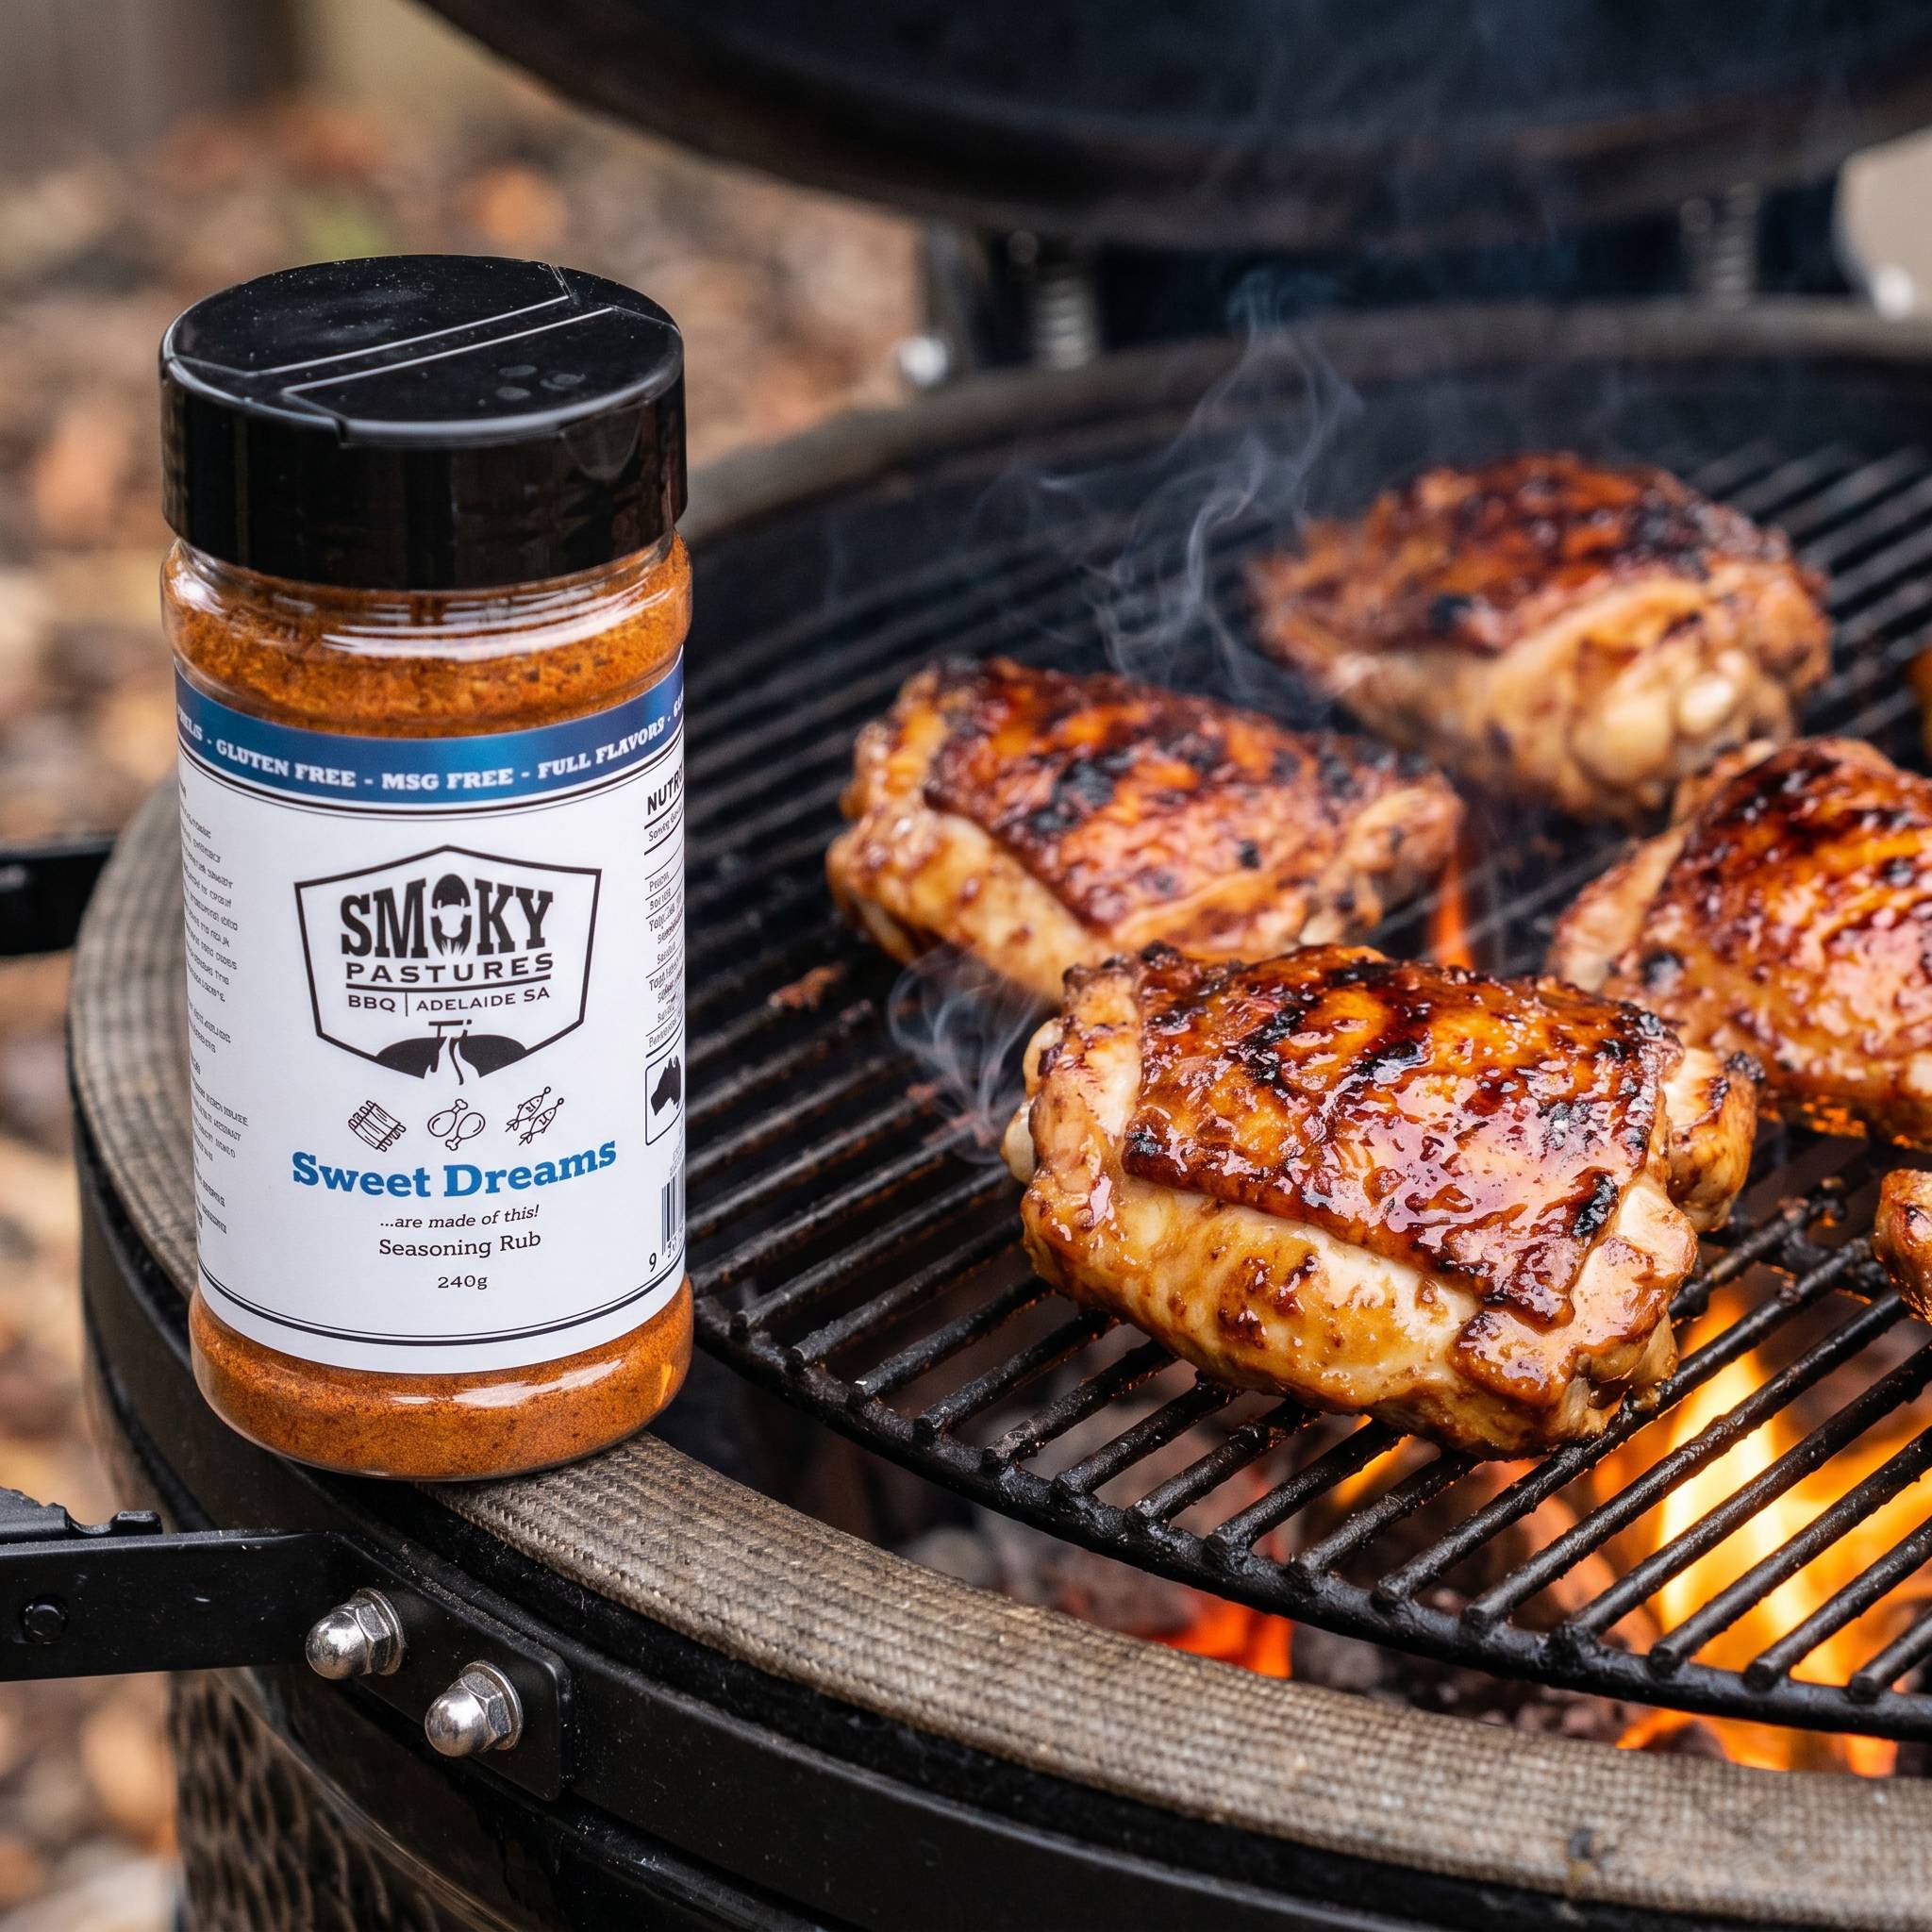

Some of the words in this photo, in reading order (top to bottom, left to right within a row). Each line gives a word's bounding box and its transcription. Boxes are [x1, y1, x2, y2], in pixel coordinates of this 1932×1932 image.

[216, 739, 290, 778] GLUTEN
[294, 761, 358, 789] FREE
[381, 772, 440, 791] MSG
[446, 768, 514, 790] FREE
[537, 753, 591, 780] FULL
[595, 715, 665, 765] FLAVORS
[340, 873, 555, 959] SMOKY
[345, 953, 554, 983] PASTURES
[347, 994, 396, 1013] BBQ
[416, 992, 516, 1012] ADELAIDE
[523, 987, 551, 1004] SA
[291, 1151, 431, 1198] Sweet
[442, 1140, 618, 1198] Dreams
[379, 1217, 424, 1229] ...are
[427, 1213, 476, 1229] made
[481, 1209, 501, 1225] of
[504, 1204, 541, 1223] this!
[378, 1238, 492, 1259] Seasoning
[498, 1230, 542, 1253] Rub
[436, 1274, 489, 1291] 240g
